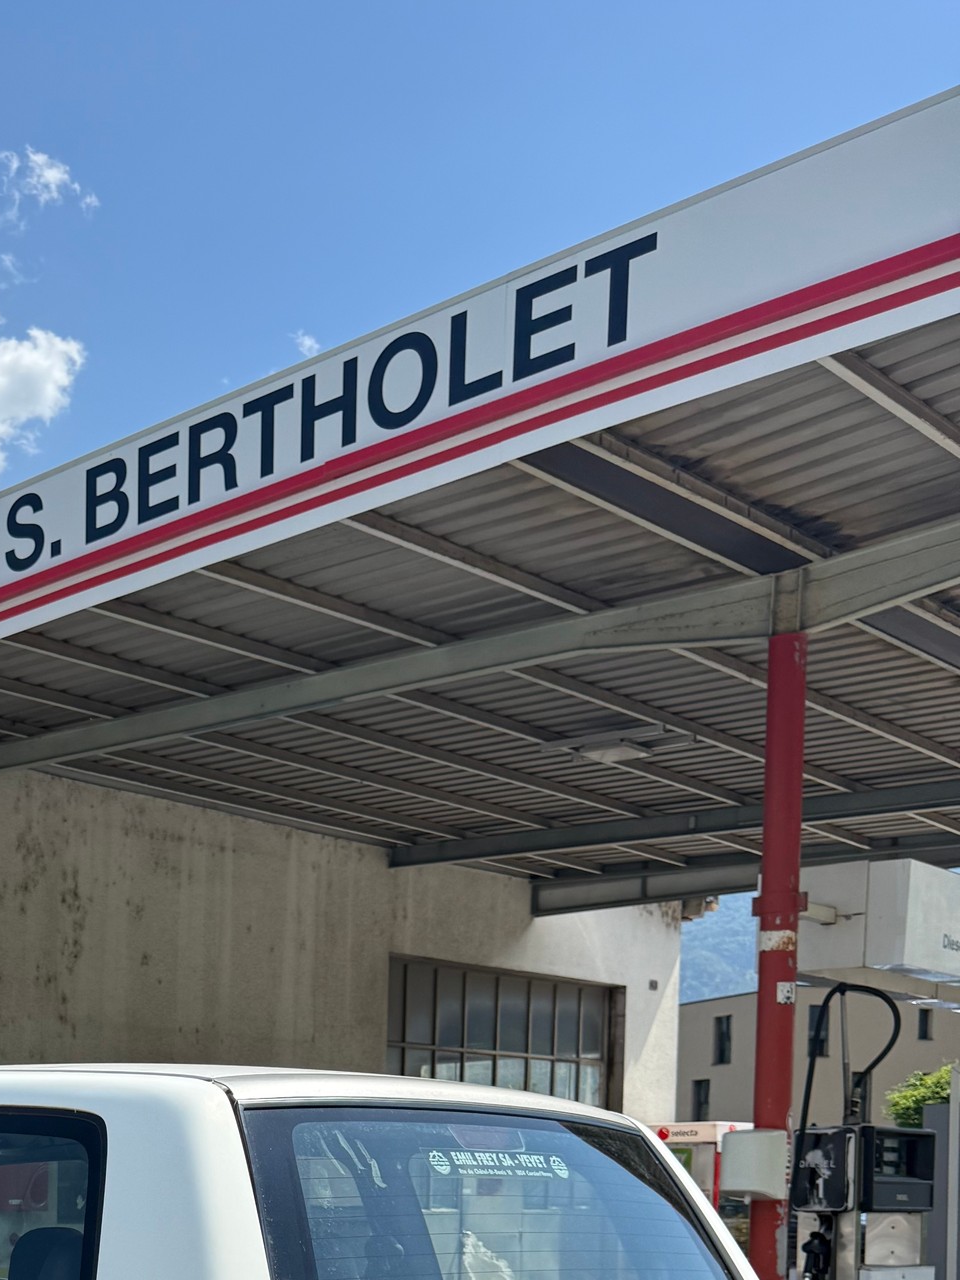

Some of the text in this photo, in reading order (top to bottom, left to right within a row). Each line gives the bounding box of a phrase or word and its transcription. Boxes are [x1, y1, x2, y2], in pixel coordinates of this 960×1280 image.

[5, 493, 61, 572] S.
[86, 232, 657, 544] BERTHOLET
[671, 1129, 698, 1137] selecta
[450, 1152, 477, 1165] EMIL
[474, 1152, 501, 1166] FREY
[499, 1153, 515, 1167] SA
[516, 1154, 548, 1168] VEVEY
